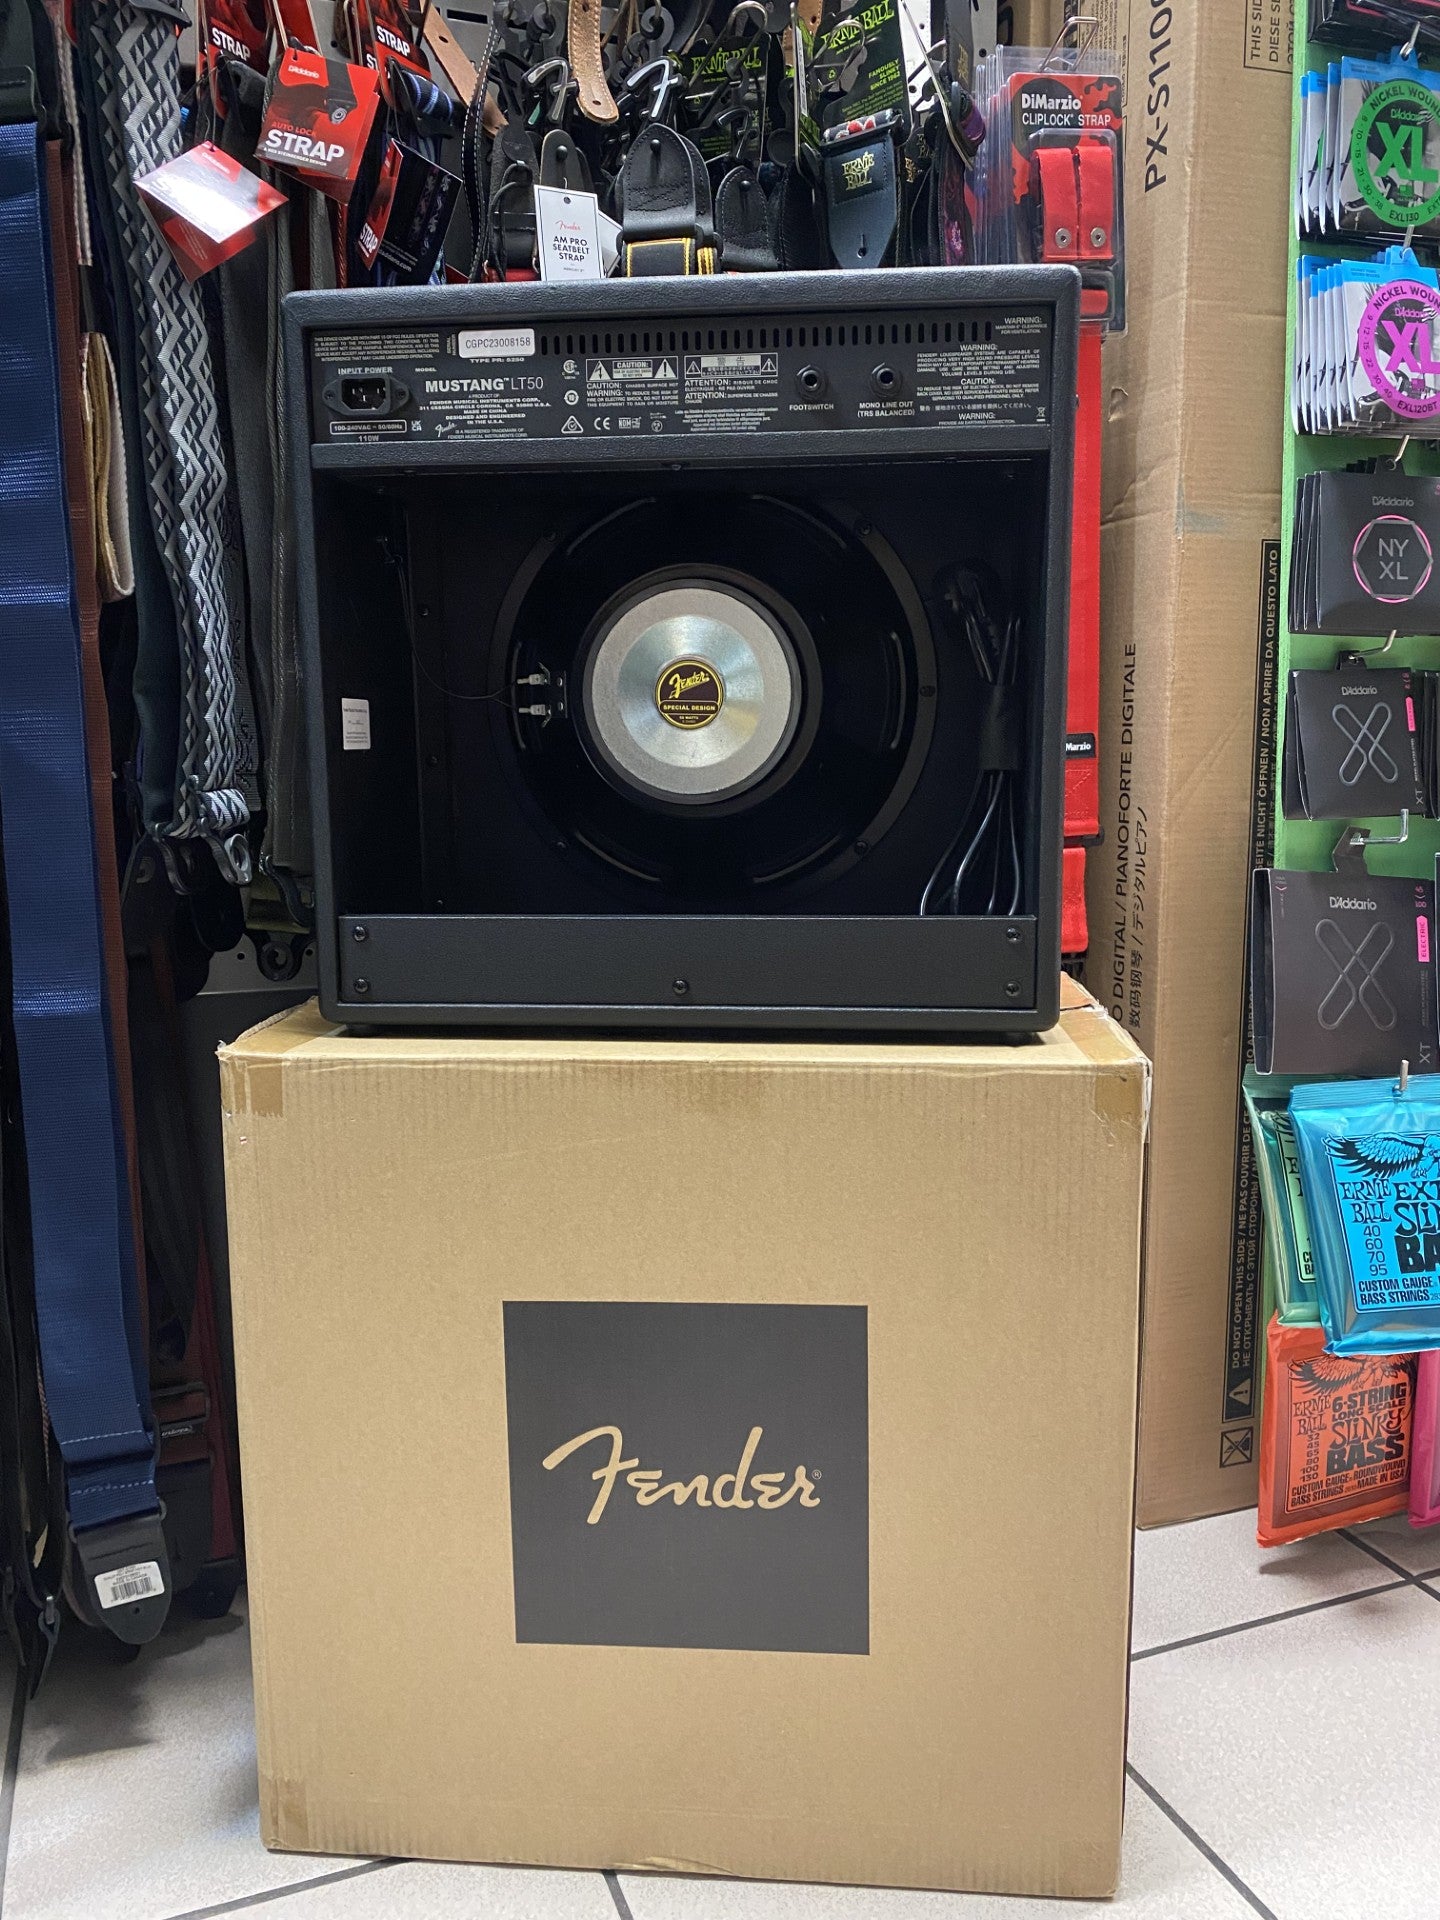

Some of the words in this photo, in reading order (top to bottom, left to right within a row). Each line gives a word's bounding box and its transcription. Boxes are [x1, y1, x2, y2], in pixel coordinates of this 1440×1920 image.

[861, 0, 895, 30] BALL
[211, 27, 251, 61] STRAP
[376, 25, 411, 57] STRAP
[1250, 25, 1261, 60] THIS
[1268, 17, 1280, 62] DIESE
[1144, 0, 1173, 193] PX-S110
[1369, 85, 1405, 111] NICKEL
[271, 121, 294, 132] AUTO
[295, 126, 317, 137] LOCK
[1078, 114, 1111, 127] STRAP
[1356, 129, 1363, 140] 10
[265, 128, 345, 162] STRAP
[1355, 149, 1361, 158] 15
[1373, 121, 1439, 183] XL
[841, 150, 875, 176] ERNIE
[845, 169, 873, 191] BALL
[1364, 185, 1373, 196] 30
[1375, 200, 1384, 210] 38
[1389, 209, 1420, 222] EXL130
[360, 222, 379, 254] STRAP
[553, 235, 568, 244] AM
[570, 238, 587, 247] PRO
[552, 243, 590, 255] SEATBELT
[559, 252, 585, 262] STRAP
[1373, 285, 1407, 310] NICKEL
[1004, 316, 1042, 324] WARNING:
[465, 338, 531, 349] CGPC23008158
[960, 343, 998, 352] WARNING:
[1381, 319, 1440, 374] XL
[337, 367, 362, 375] INPUT
[364, 366, 393, 374] POWER
[511, 376, 544, 391] LT50
[587, 382, 621, 390] CAUTION:
[789, 403, 834, 411] FOOTSWITCH
[857, 410, 871, 418] (TRS
[875, 408, 915, 417] BALANCED)
[958, 412, 996, 420] WARNING:
[1397, 400, 1438, 414] EXL120BT
[1372, 495, 1415, 507] D'Addario
[1378, 538, 1410, 558] NY
[1268, 549, 1278, 583] LATO
[1379, 561, 1409, 580] XL
[1266, 585, 1277, 638] QUESTO
[1265, 640, 1275, 659] DA
[668, 671, 710, 699] Fender
[1262, 662, 1273, 706] APRIRE
[1341, 686, 1378, 696] D'Addario
[1121, 643, 1136, 746] DIGITALE
[1261, 707, 1271, 737] NON
[1065, 741, 1092, 752] Marzio
[1256, 747, 1269, 798] ÖFFNEN
[1415, 788, 1424, 805] XT
[1115, 751, 1132, 898] PIANOFORTE
[1256, 800, 1267, 838] NICHT
[1131, 806, 1147, 930] デジタルピアノ
[1329, 896, 1377, 911] D'Addario
[1112, 915, 1127, 1000] DIGITAL
[1129, 950, 1143, 1029] 数码钢琴
[1419, 1041, 1431, 1064] XT
[1242, 1126, 1251, 1142] DE
[1240, 1145, 1250, 1188] OUVRIR
[1338, 1172, 1392, 1201] ERNIE
[1239, 1190, 1248, 1211] PAS
[1239, 1213, 1247, 1229] NE
[1248, 1181, 1259, 1243] СТОРОНЫ
[1350, 1200, 1393, 1224] BALL
[1363, 1225, 1381, 1238] 40
[1237, 1238, 1246, 1263] SIDE
[1365, 1238, 1383, 1251] 60
[1245, 1244, 1256, 1270] ЭТОЙ
[1367, 1251, 1386, 1264] 70
[1236, 1265, 1245, 1289] THIS
[1247, 1273, 1255, 1281] С
[1369, 1264, 1388, 1277] 95
[1358, 1279, 1400, 1293] CUSTOM
[1402, 1276, 1433, 1290] GAUGE
[1234, 1291, 1243, 1323] OPEN
[1360, 1292, 1387, 1306] BASS
[1388, 1289, 1430, 1304] STRINGS
[1243, 1283, 1254, 1350] ОТКРЫВАТЬ
[1233, 1325, 1242, 1349] NOT
[1232, 1351, 1240, 1369] DO
[1242, 1352, 1250, 1367] НЕ
[1293, 1390, 1331, 1417] ERNIE
[1332, 1381, 1407, 1413] 6-STRING
[1333, 1407, 1364, 1422] LONG
[1368, 1398, 1406, 1414] SCALE
[1297, 1412, 1327, 1436] BALL
[1306, 1449, 1320, 1458] 65
[1307, 1441, 1320, 1449] 45
[1307, 1433, 1320, 1442] 32
[1326, 1432, 1405, 1476] BASS
[1300, 1464, 1319, 1474] 100
[1306, 1457, 1320, 1466] 80
[1292, 1479, 1324, 1497] CUSTOM
[1325, 1473, 1350, 1488] GAUGE
[1353, 1458, 1406, 1480] ROUNDWOUND
[1300, 1472, 1319, 1482] 130
[1291, 1492, 1312, 1507] BASS
[1312, 1485, 1344, 1503] STRINGS
[1357, 1475, 1378, 1489] MADE
[1379, 1473, 1388, 1483] IN
[1390, 1469, 1406, 1481] USA
